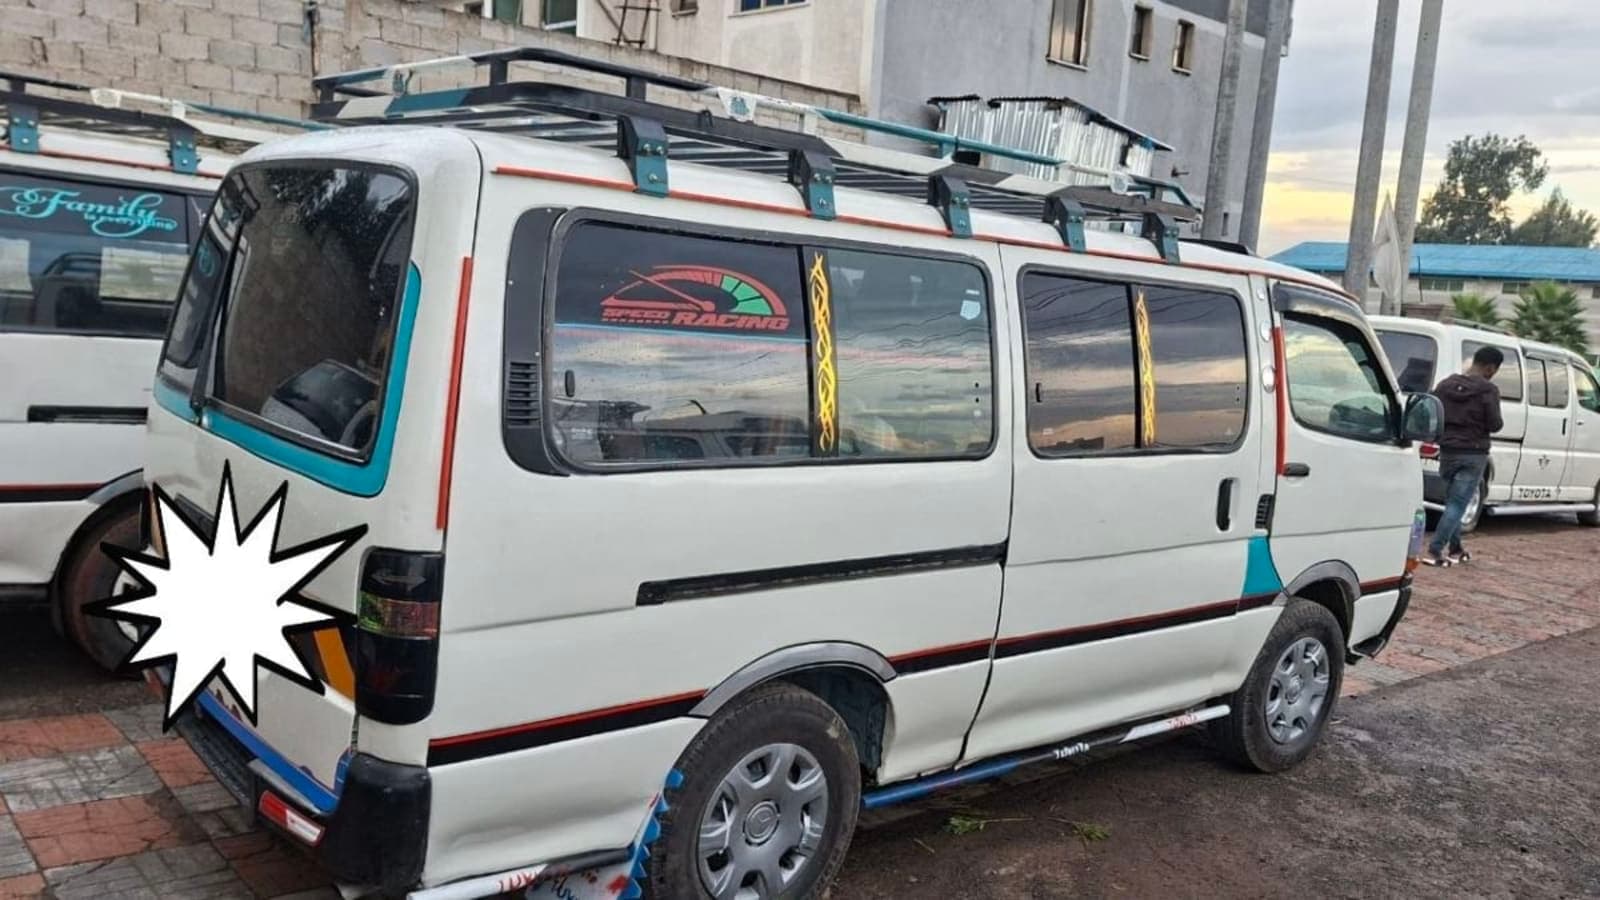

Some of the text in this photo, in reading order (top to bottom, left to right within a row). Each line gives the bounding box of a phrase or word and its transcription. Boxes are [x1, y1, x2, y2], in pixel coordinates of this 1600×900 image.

[4, 186, 163, 237] Family
[601, 308, 671, 320] SPEED
[672, 311, 790, 331] RACING
[1518, 488, 1551, 498] TOYOTA
